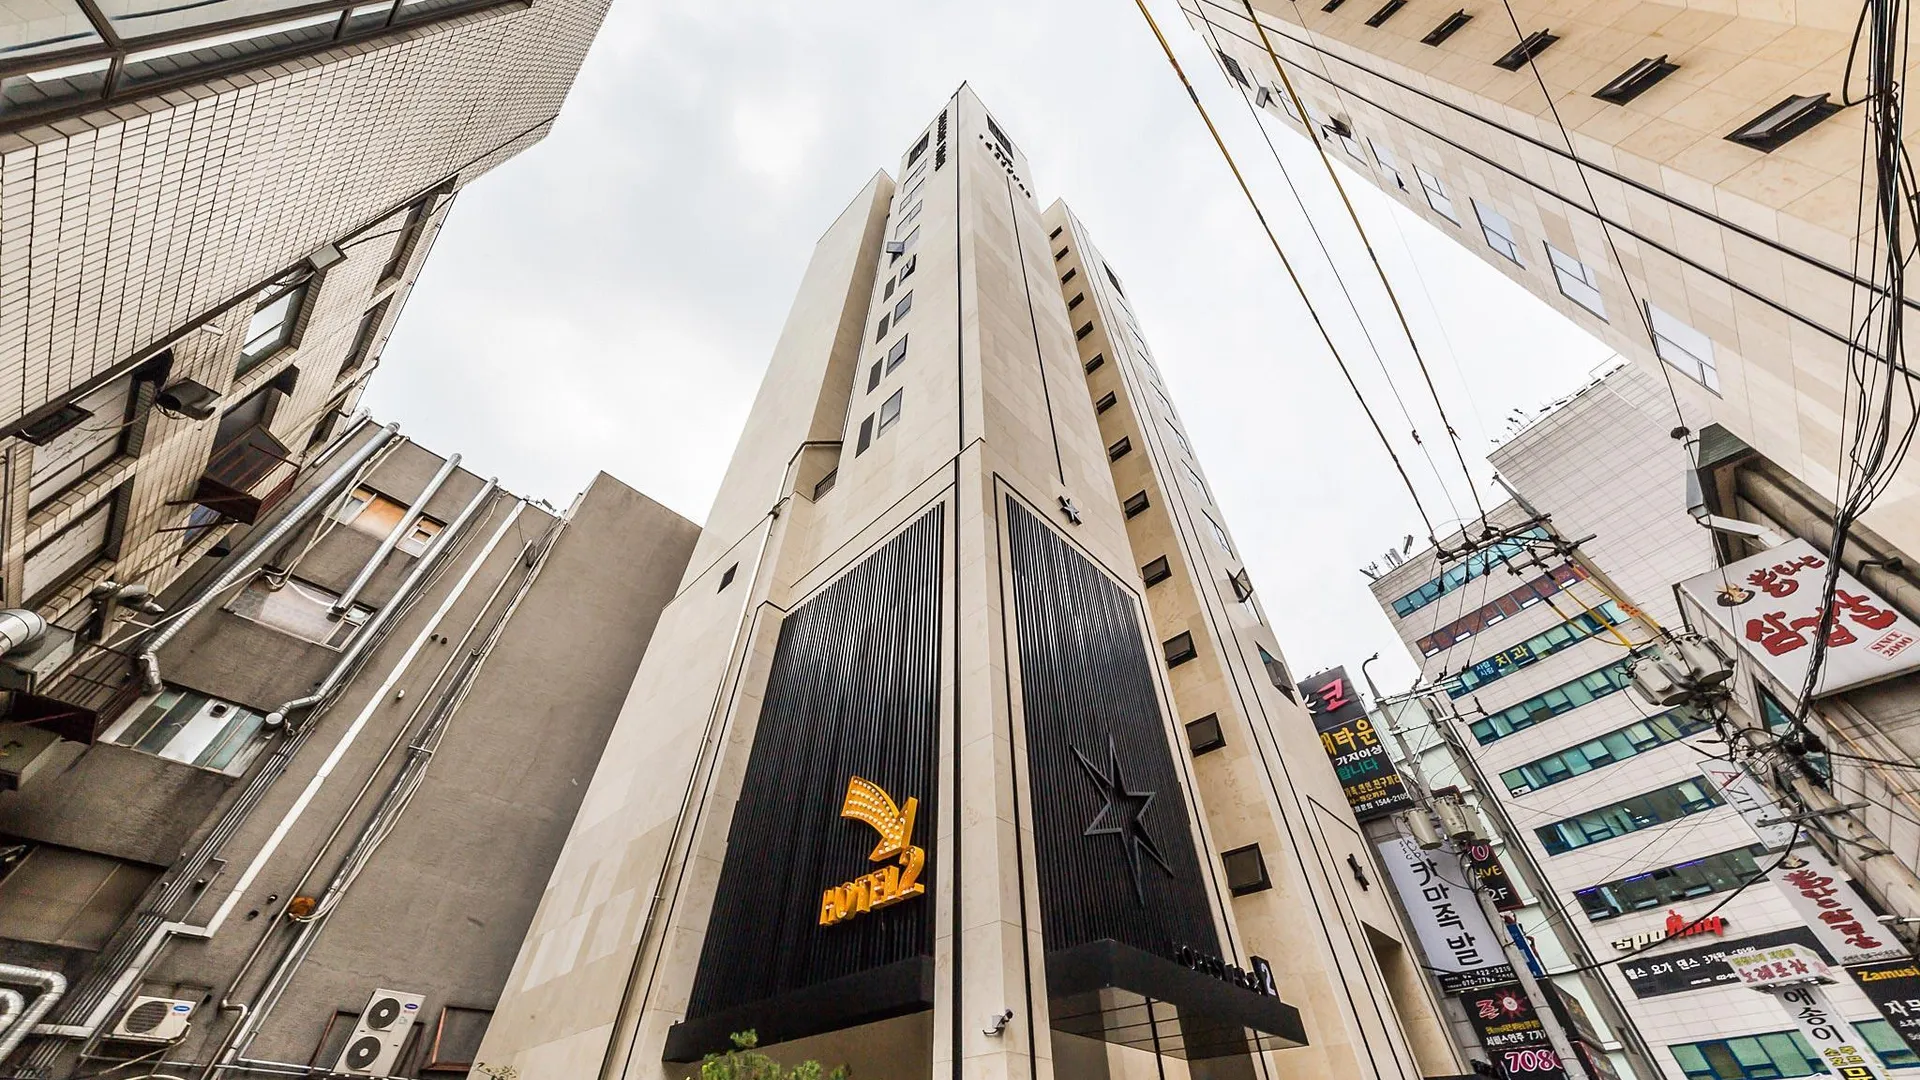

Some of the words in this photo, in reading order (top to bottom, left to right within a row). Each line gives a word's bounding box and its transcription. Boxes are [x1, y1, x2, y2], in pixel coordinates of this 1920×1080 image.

[1495, 644, 1529, 667] 치과
[1872, 631, 1902, 652] SINCE
[1882, 637, 1914, 659] 2000
[1317, 678, 1350, 712] 코
[819, 865, 900, 926] HOTEL
[1410, 857, 1484, 967] 카마족발
[1651, 961, 1674, 976] 요가
[1676, 957, 1701, 971] 댄스
[1783, 986, 1846, 1043] 애송이
